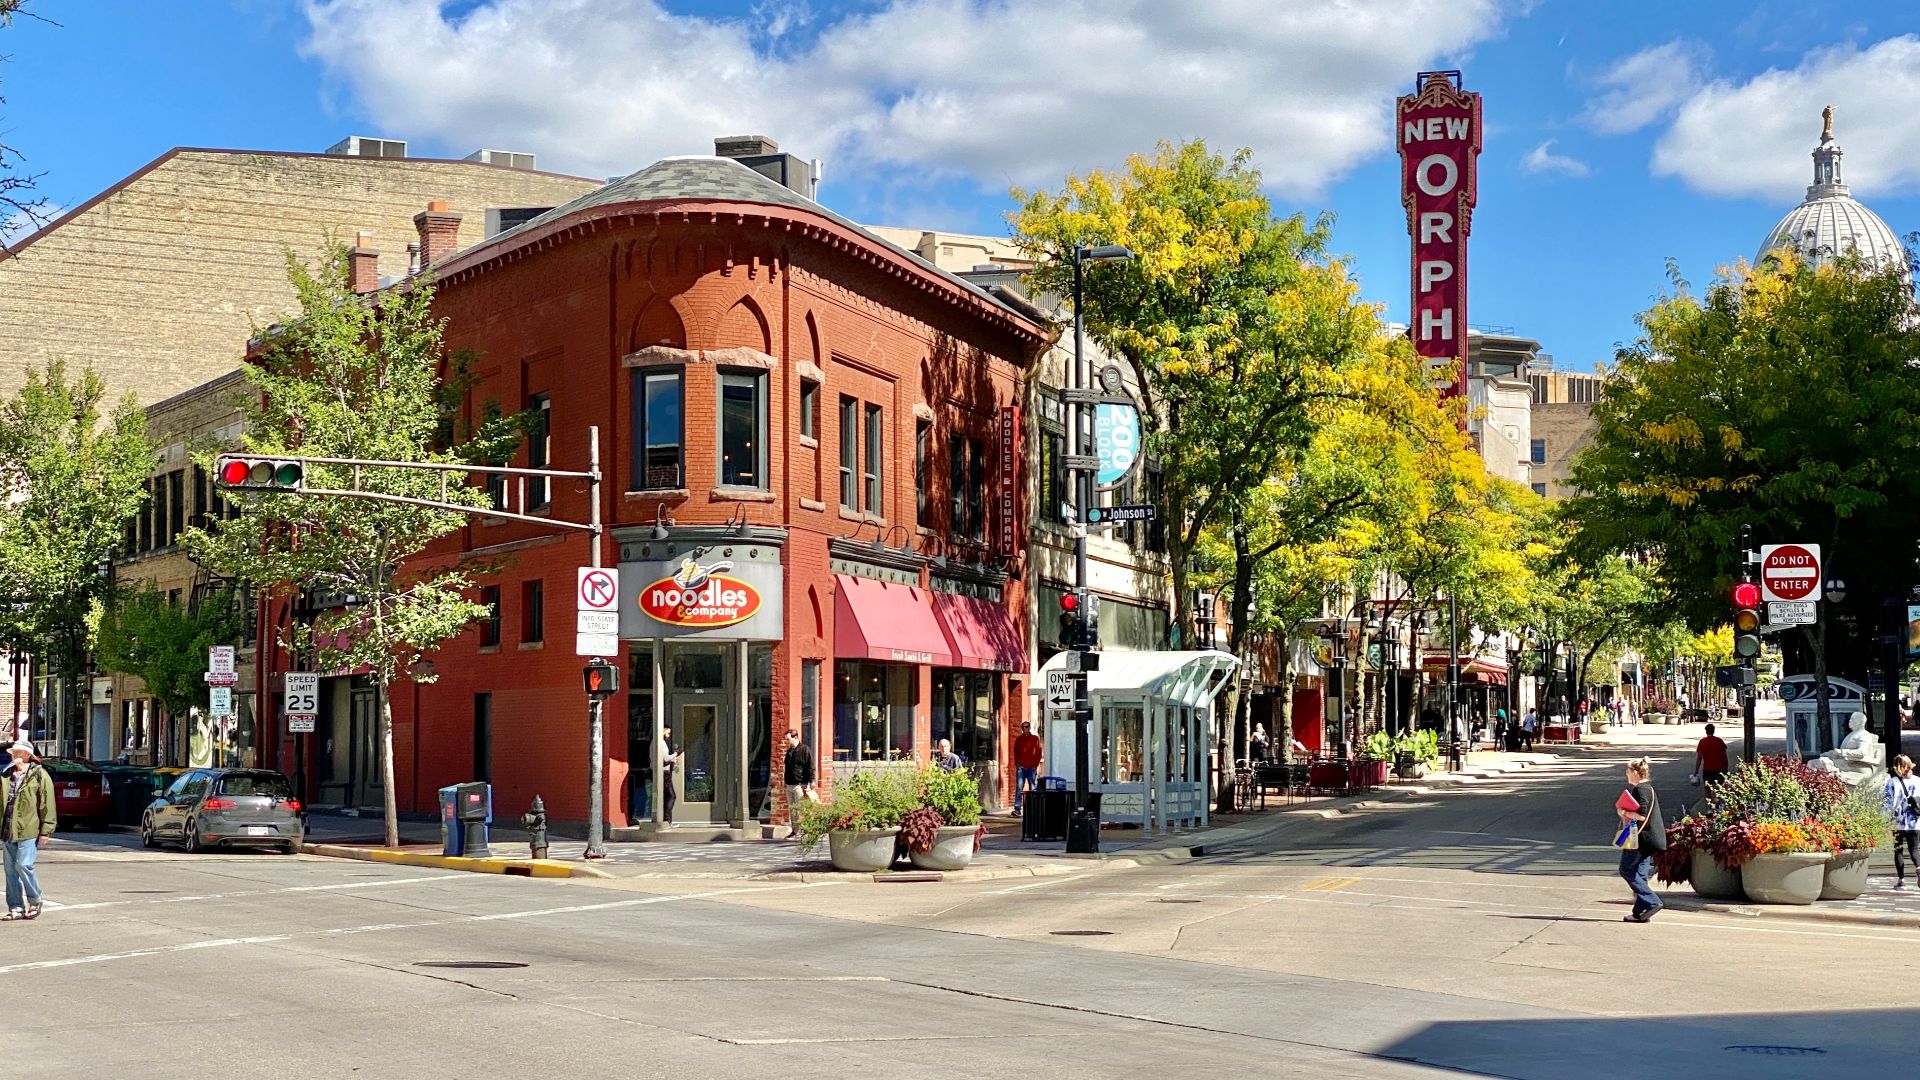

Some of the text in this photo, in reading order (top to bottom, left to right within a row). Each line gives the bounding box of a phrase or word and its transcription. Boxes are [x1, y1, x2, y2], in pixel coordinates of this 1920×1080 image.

[1404, 116, 1470, 145] NEW
[1110, 404, 1134, 471] 200
[1099, 416, 1112, 473] BLOCK
[1003, 411, 1012, 551] NOODLES & COMPANY
[1108, 508, 1145, 520] Johnson
[1772, 555, 1810, 566] DO NOT
[1773, 580, 1809, 590] ENTER
[652, 579, 748, 607] noodles
[597, 615, 615, 623] STATE
[587, 622, 609, 630] STREET
[1050, 674, 1071, 683] ONE
[1049, 685, 1071, 694] WAY
[288, 695, 315, 710] 25
